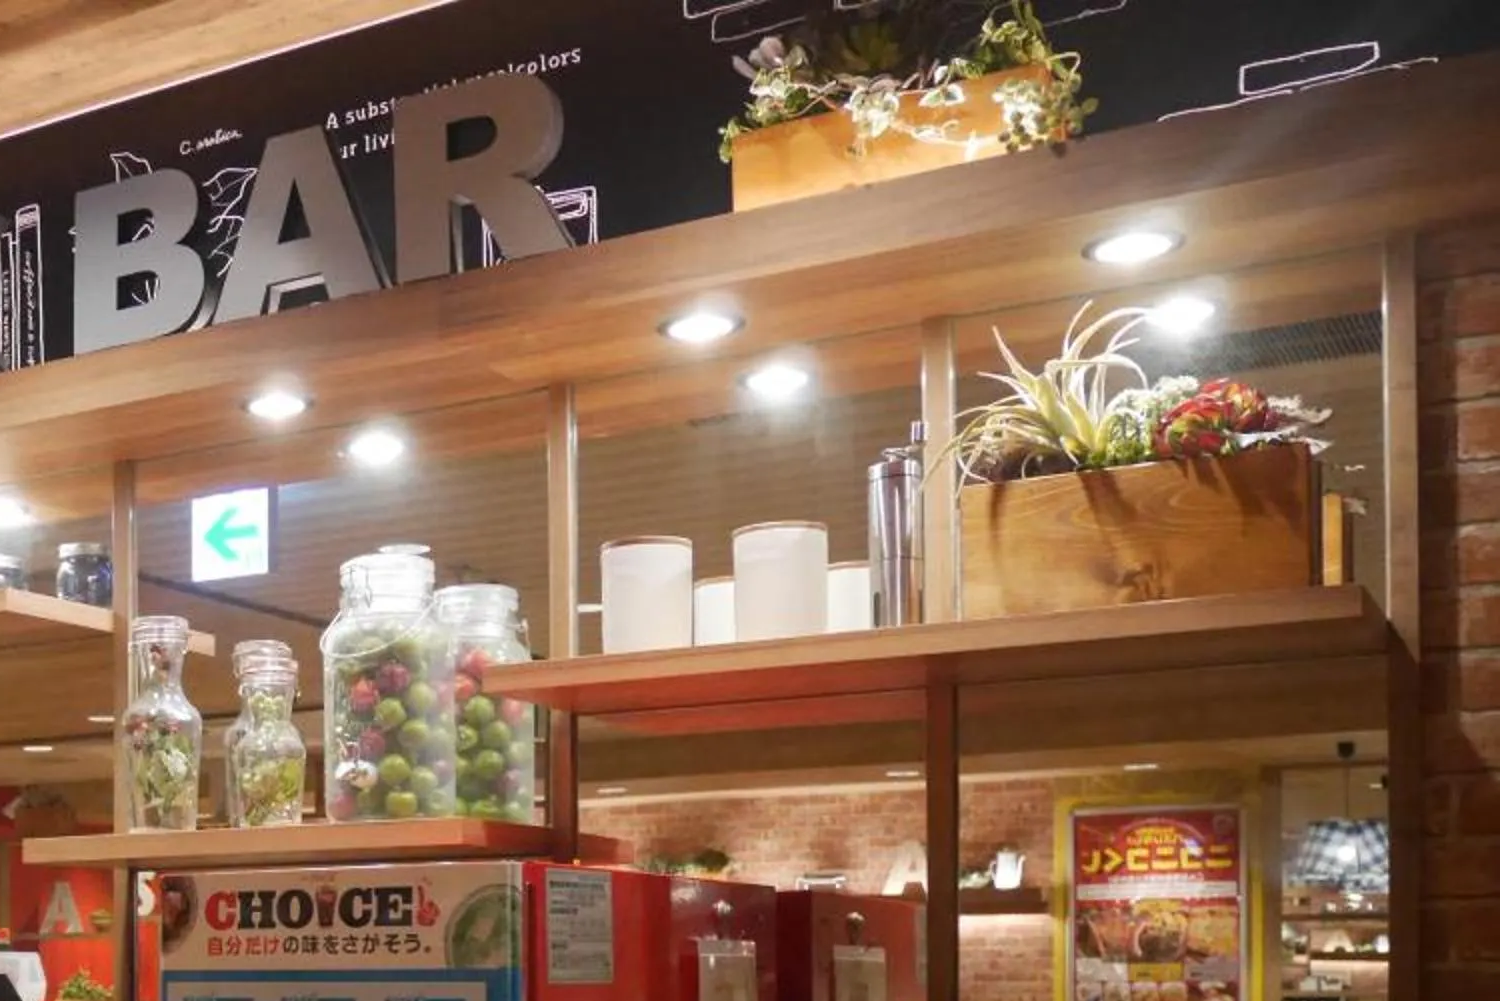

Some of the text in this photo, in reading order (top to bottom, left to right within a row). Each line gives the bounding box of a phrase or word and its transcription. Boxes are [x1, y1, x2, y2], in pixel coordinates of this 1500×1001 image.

[326, 112, 339, 130] A
[340, 143, 357, 159] ur
[74, 74, 580, 357] BAR
[40, 881, 82, 935] A
[207, 932, 432, 957] 自分だけの味をさがそう。
